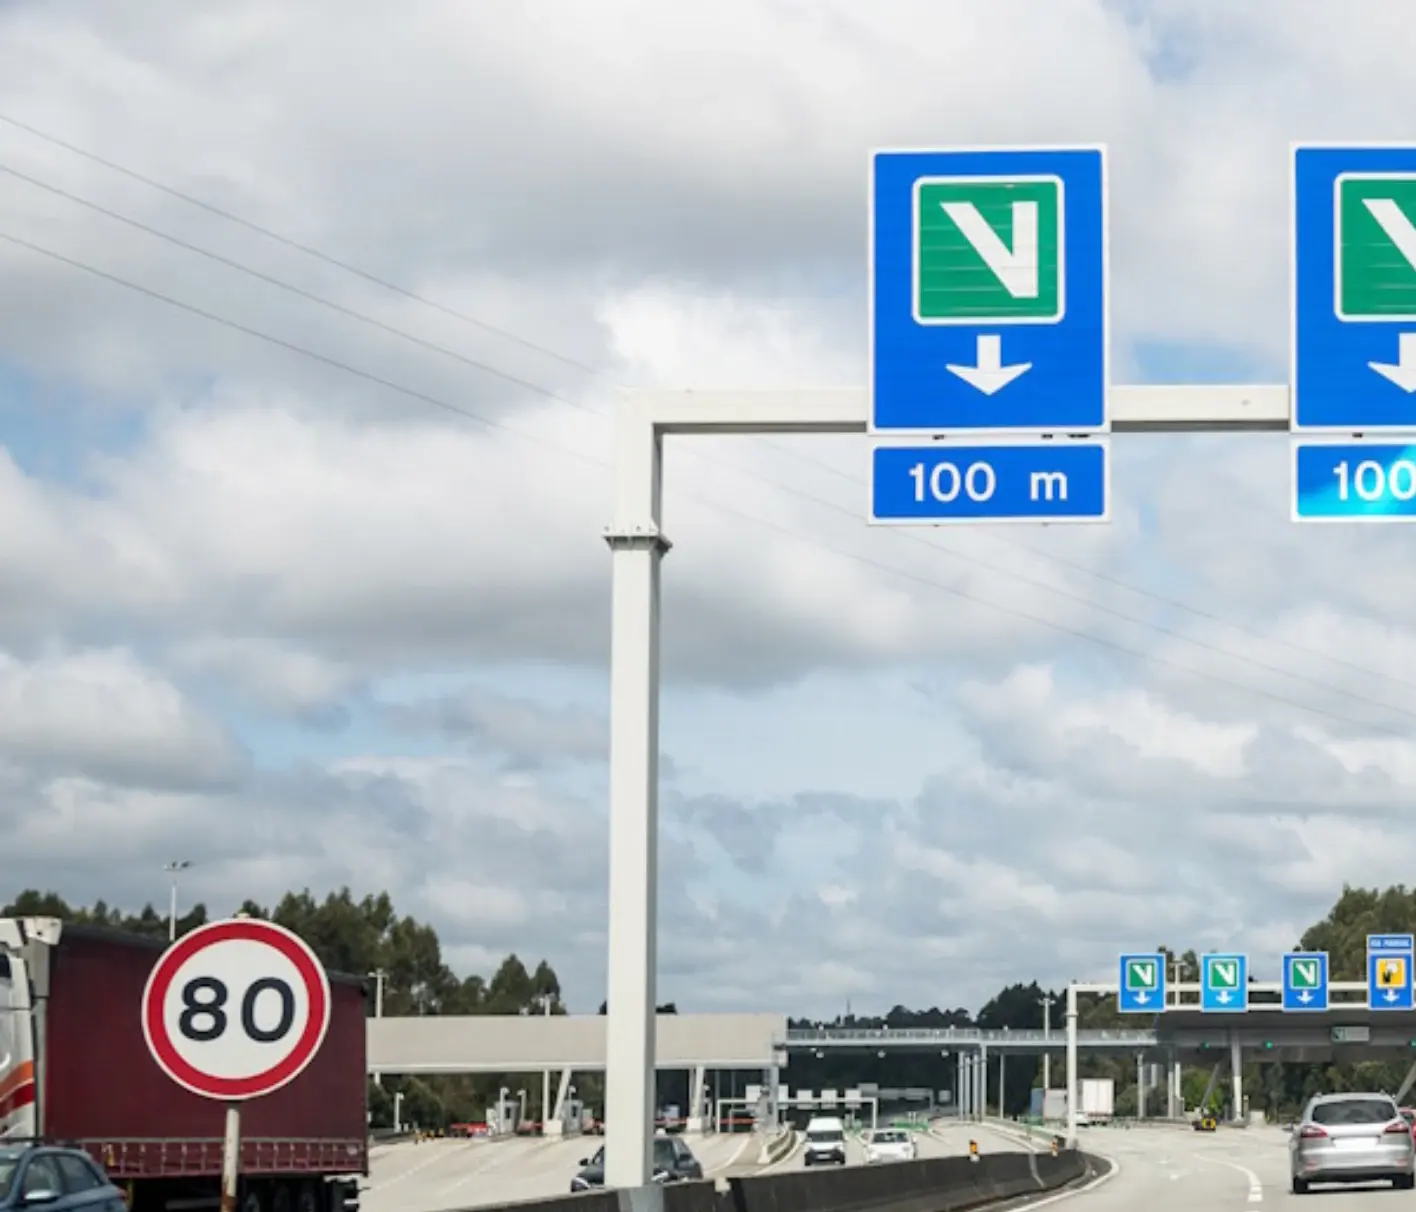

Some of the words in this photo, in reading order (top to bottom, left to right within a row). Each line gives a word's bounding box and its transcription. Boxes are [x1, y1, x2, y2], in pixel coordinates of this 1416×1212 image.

[909, 461, 996, 502] 100
[1030, 471, 1068, 501] m
[178, 976, 295, 1043] 80
